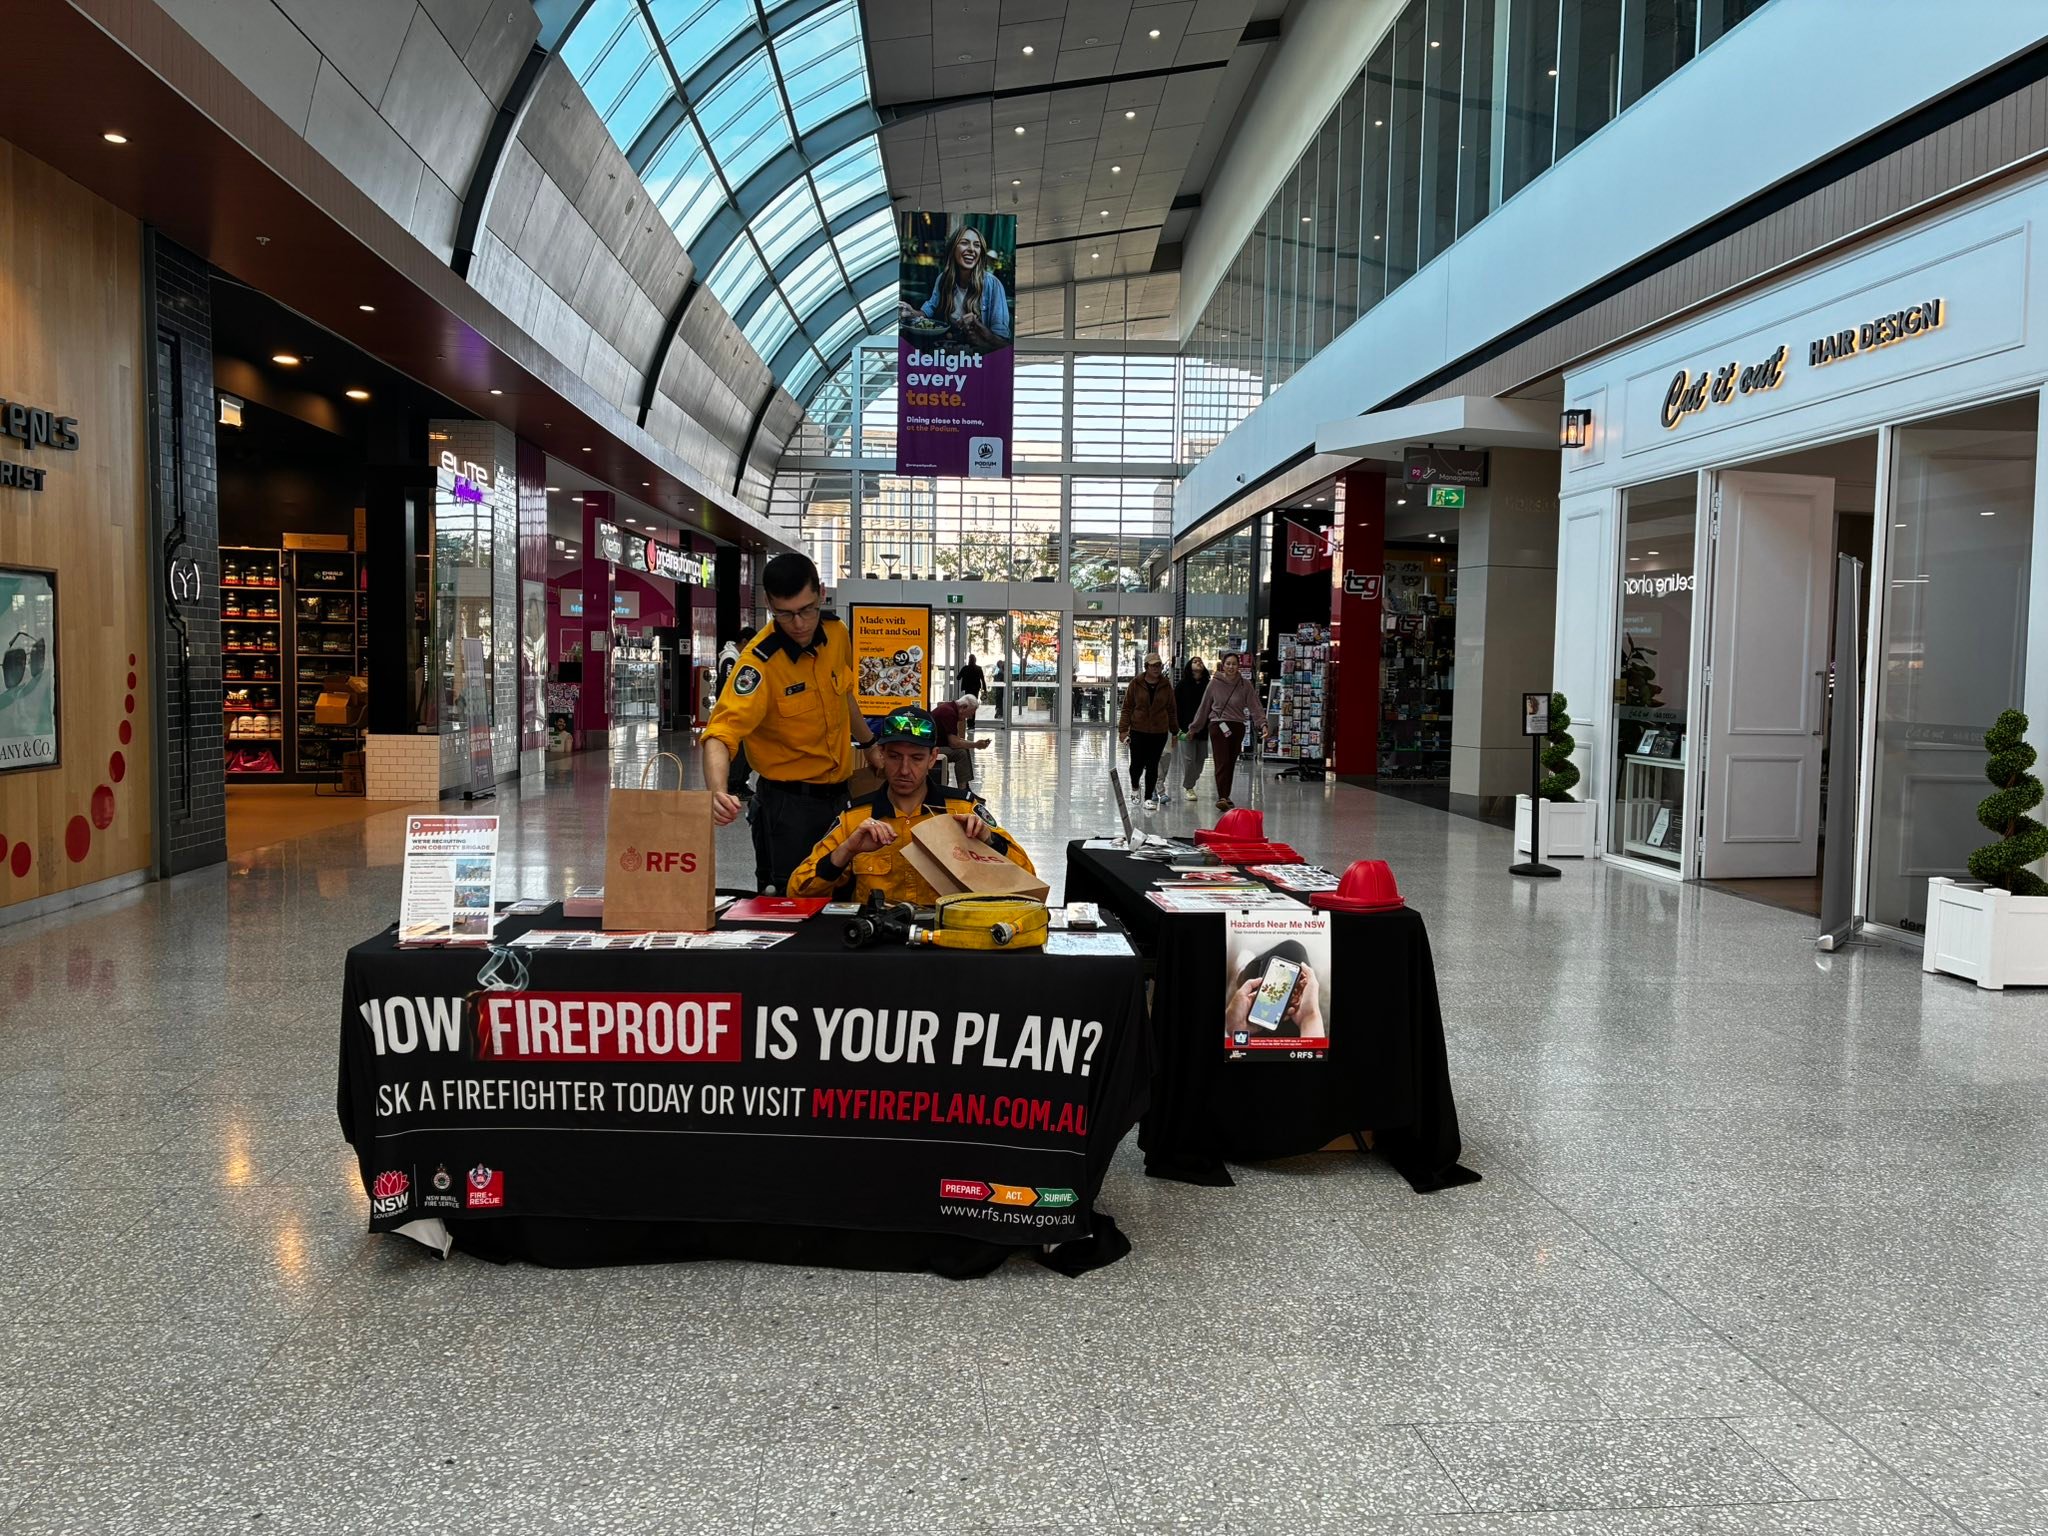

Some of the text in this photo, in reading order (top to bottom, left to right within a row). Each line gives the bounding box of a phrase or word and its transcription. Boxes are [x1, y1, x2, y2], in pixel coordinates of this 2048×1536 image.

[906, 348, 983, 372] delight
[1661, 298, 1941, 428] Cut it out HAIR DESIGN
[906, 373, 967, 392] every
[906, 390, 966, 406] taste.
[906, 416, 930, 425] Dining
[961, 418, 985, 426] home,
[1438, 473, 1481, 482] Management
[1457, 468, 1480, 476] Centre
[1289, 540, 1317, 561] tsg
[1343, 568, 1382, 600] tsg
[860, 616, 906, 625] Made with
[860, 627, 921, 636] Heart and Soul
[646, 851, 697, 873] RFS
[1230, 920, 1326, 929] Hazards Near Me NSW
[488, 997, 731, 1055] FIREPROOF
[755, 1005, 799, 1060] IS
[812, 1007, 940, 1064] YOUR
[951, 1010, 1103, 1077] PLAN?
[1297, 1051, 1313, 1059] RFS
[376, 1079, 1088, 1136] SK A FIREFIGHTER TODAY OR VISIT MYFIREPLAN.COM.AU
[945, 1184, 983, 1195] PREPARE.
[1005, 1191, 1023, 1200] ACT.
[373, 1192, 409, 1213] NSW
[469, 1198, 500, 1206] RESCUE
[940, 1204, 1076, 1228] www.rfs.nsw.gov.au
